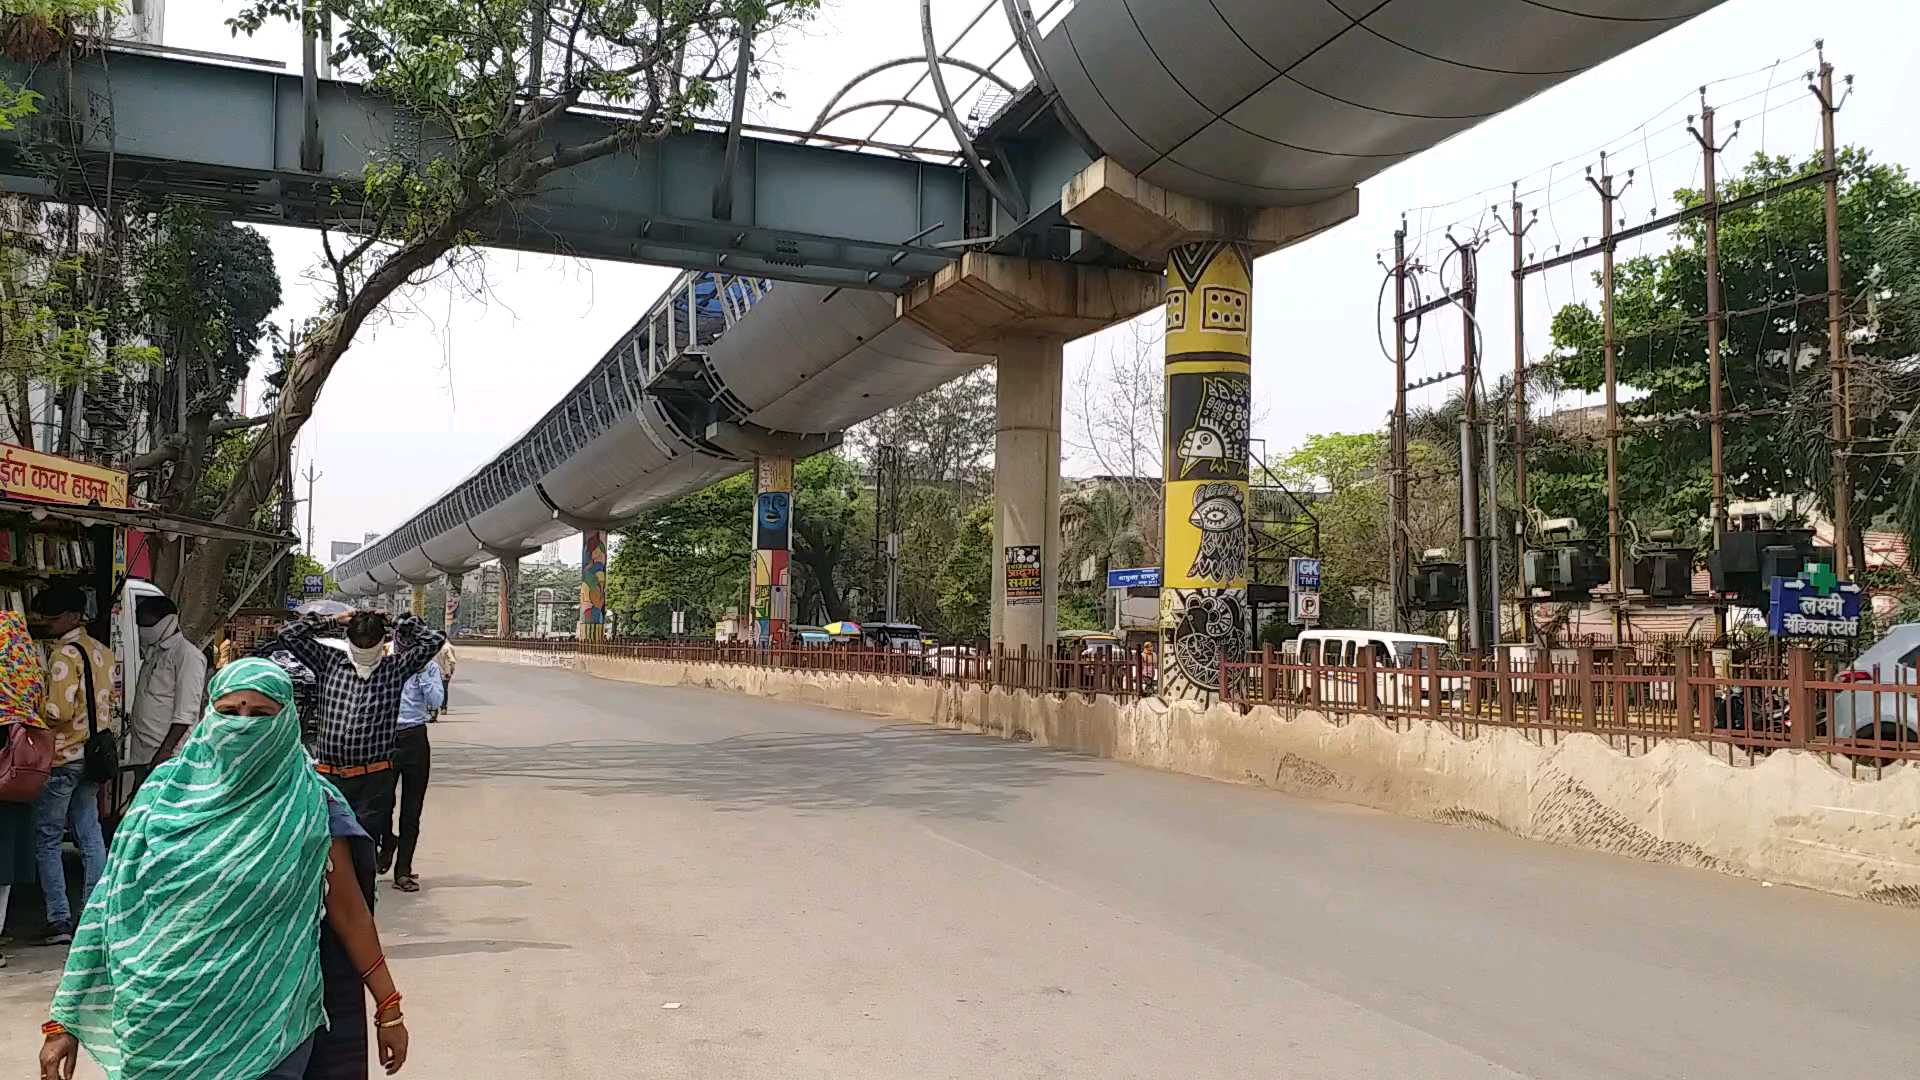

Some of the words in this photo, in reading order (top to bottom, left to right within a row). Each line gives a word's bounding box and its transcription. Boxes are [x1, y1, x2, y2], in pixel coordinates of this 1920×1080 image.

[30, 464, 69, 495] कवर
[1300, 561, 1319, 575] GK
[304, 575, 322, 585] GK
[1300, 576, 1319, 585] TMT
[1799, 593, 1845, 616] लक्ष्मी
